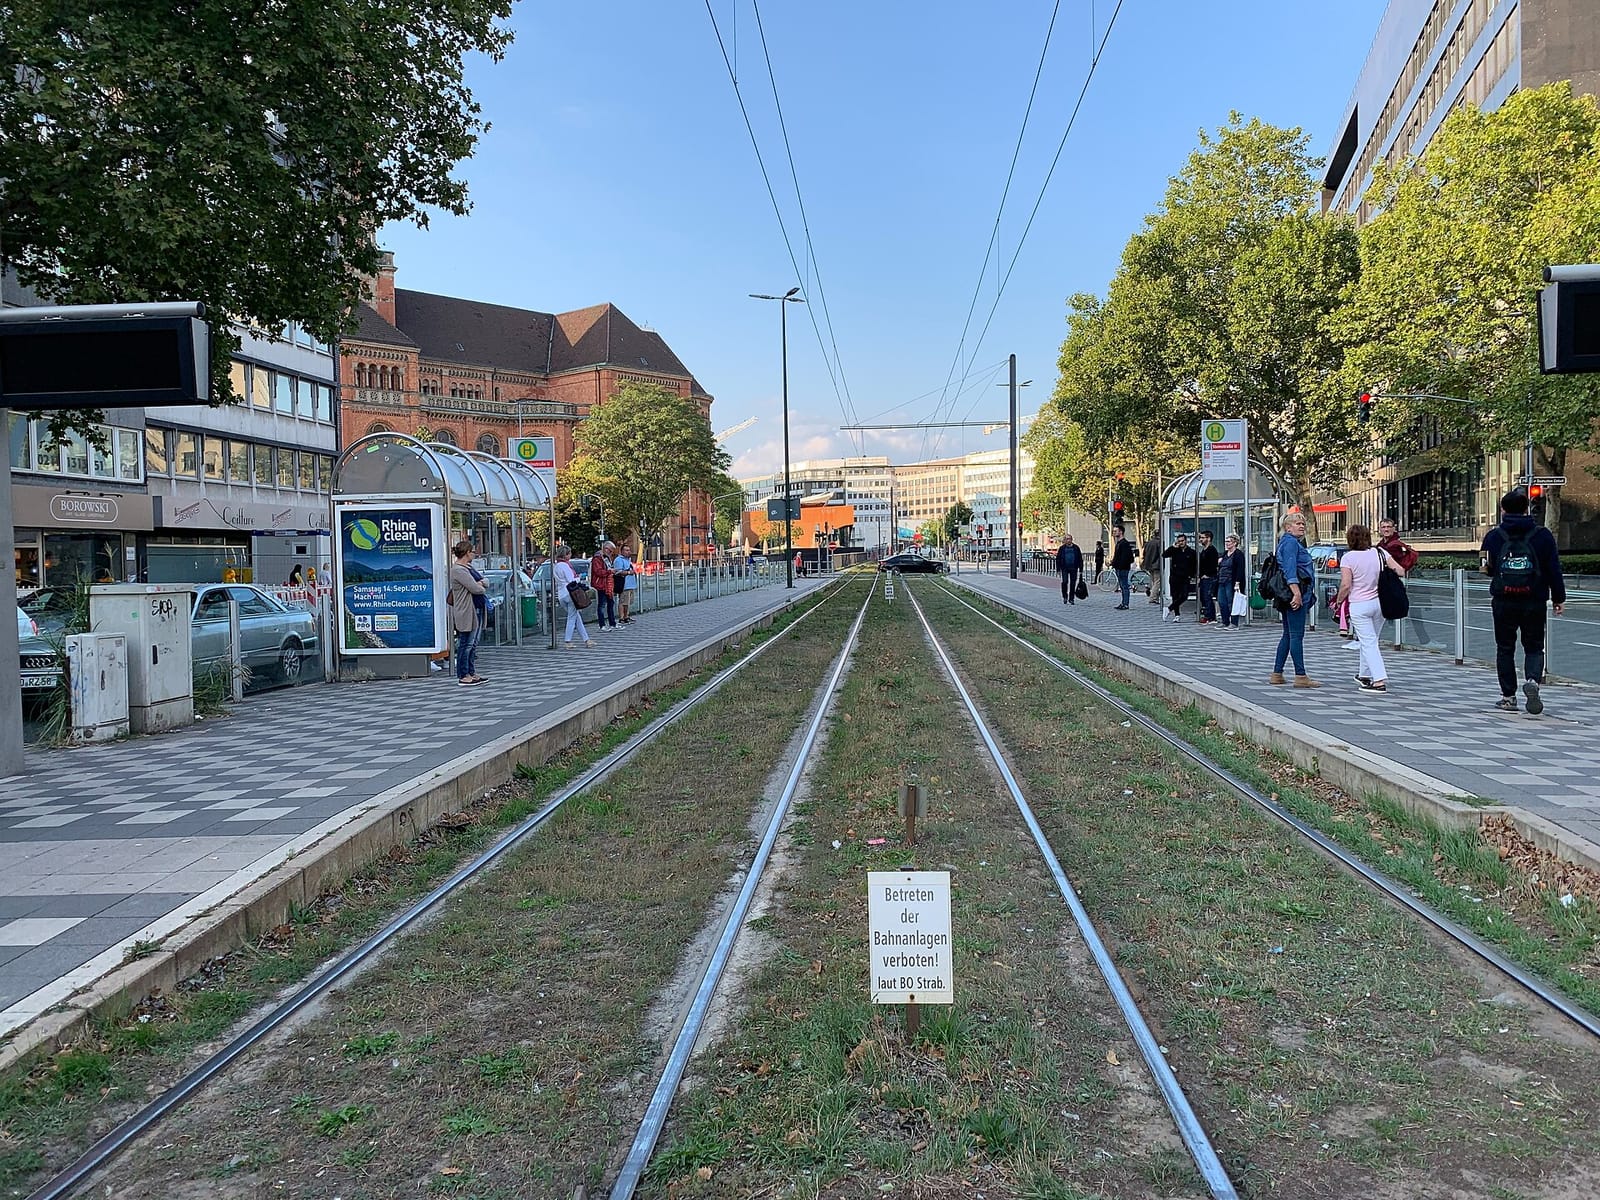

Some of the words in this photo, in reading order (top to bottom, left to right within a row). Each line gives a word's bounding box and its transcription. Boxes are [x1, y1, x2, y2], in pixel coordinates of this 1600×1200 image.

[60, 500, 109, 513] BOROWSKI
[381, 519, 417, 532] Rhine
[384, 529, 416, 541] clean
[414, 537, 430, 550] up
[353, 586, 382, 594] Samstag
[393, 584, 410, 593] Sept.
[410, 584, 427, 592] 2019
[353, 600, 432, 608] www.RhineCleanUp.org
[884, 887, 935, 902] Betreten
[900, 907, 919, 923] der
[874, 930, 947, 949] Bahnanlagen
[882, 952, 939, 968] verboten!
[877, 976, 897, 990] laut
[899, 976, 914, 990] BO
[916, 976, 946, 990] Strab.
